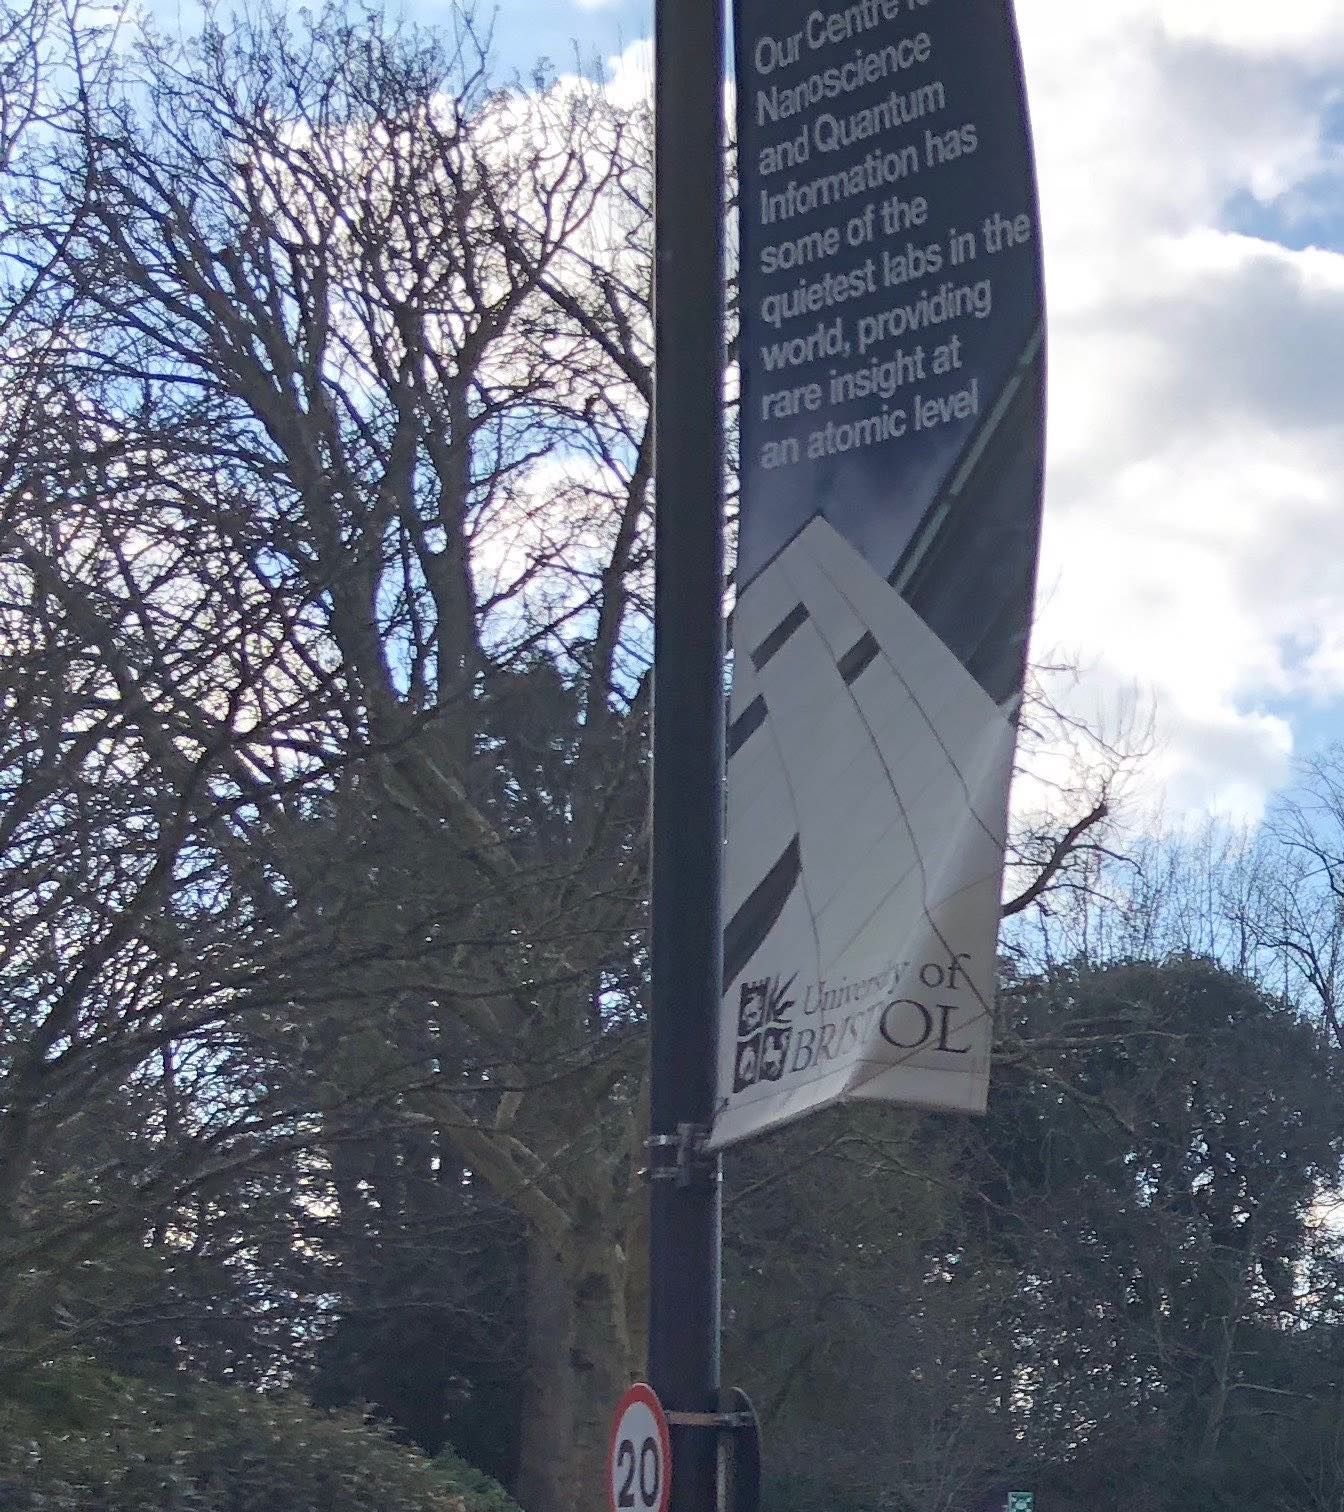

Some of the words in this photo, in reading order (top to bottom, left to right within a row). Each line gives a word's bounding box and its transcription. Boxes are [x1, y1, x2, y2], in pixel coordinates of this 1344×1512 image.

[755, 31, 802, 75] Our
[806, 0, 899, 48] Centre
[756, 32, 932, 127] Nanoscience
[758, 134, 808, 176] and
[813, 80, 946, 154] Quantum
[760, 142, 919, 225] Information
[925, 122, 979, 166] has
[760, 230, 839, 275] some
[847, 213, 877, 248] of
[880, 197, 929, 233] the
[762, 259, 877, 329] quietest
[884, 243, 943, 288] labs
[948, 228, 977, 265] in
[983, 213, 1031, 254] the
[761, 318, 850, 371] world,
[858, 279, 992, 354] providing
[762, 383, 819, 421] rare
[829, 350, 925, 401] insight
[932, 335, 963, 374] at
[760, 436, 800, 470] an
[807, 407, 907, 461] atomic
[914, 379, 980, 428] level
[919, 953, 971, 990] of
[618, 1437, 659, 1507] 20
